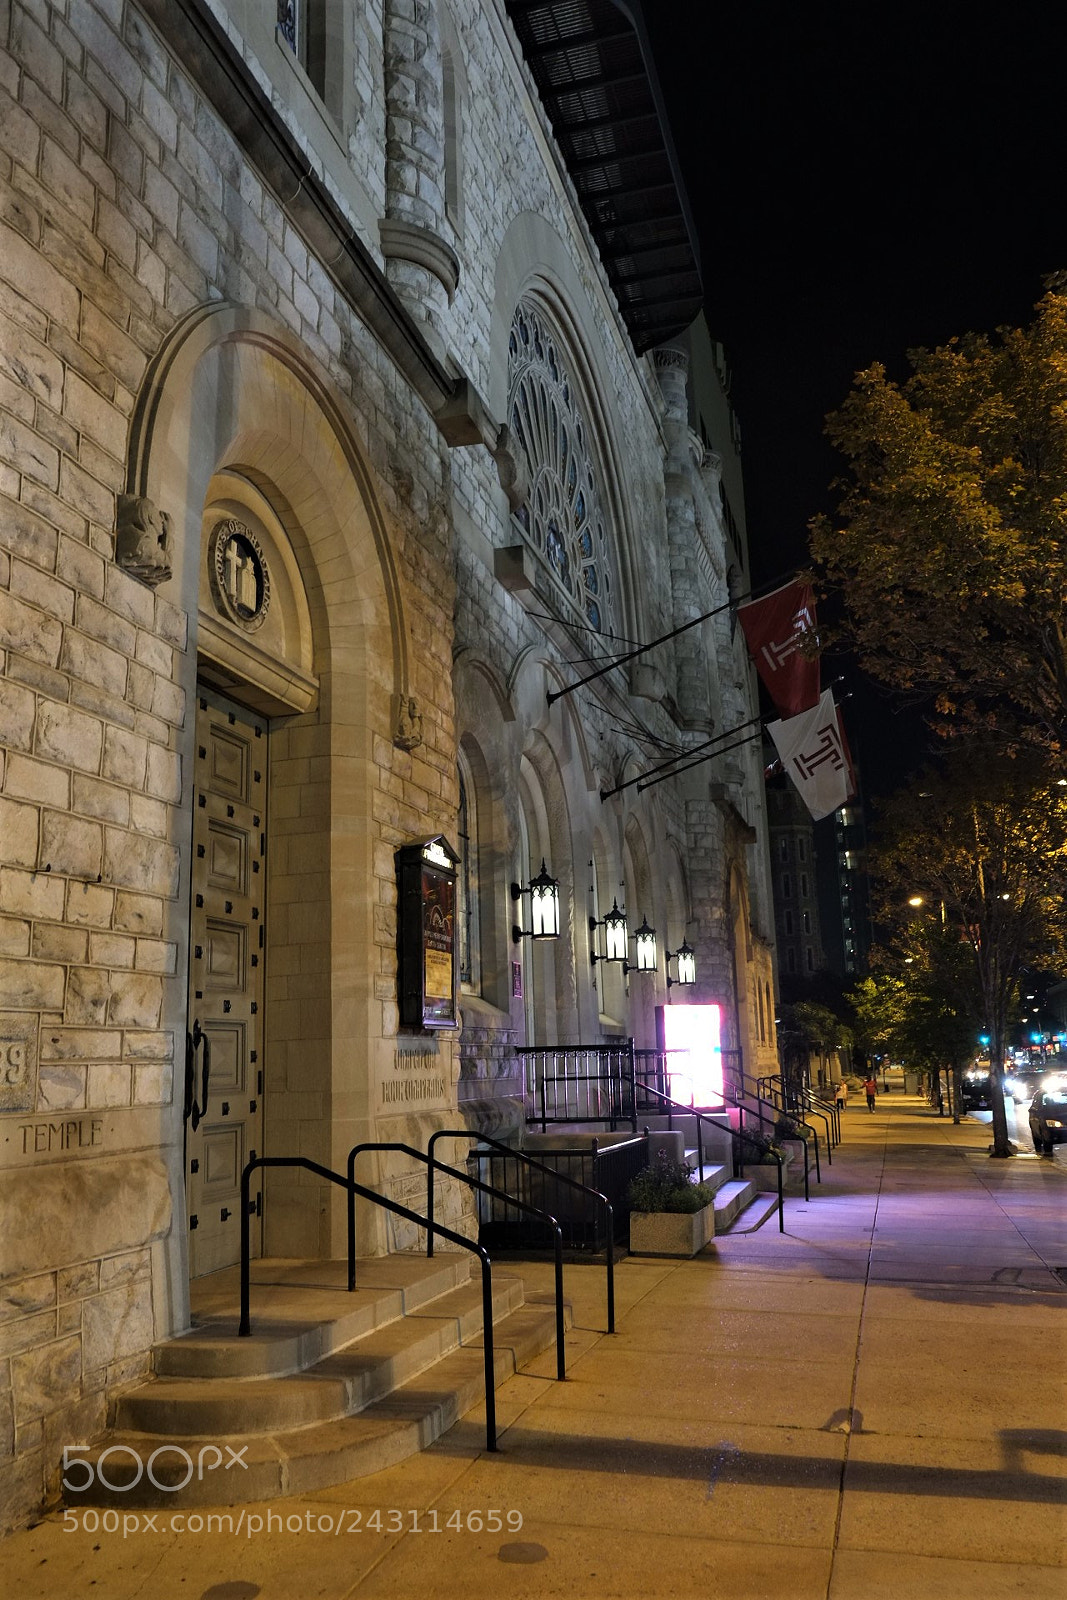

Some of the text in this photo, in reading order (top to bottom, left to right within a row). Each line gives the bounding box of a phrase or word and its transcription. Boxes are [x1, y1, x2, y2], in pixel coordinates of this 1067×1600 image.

[214, 531, 227, 585] CORPS
[228, 520, 239, 532] OF
[18, 1119, 103, 1154] TEMPLE
